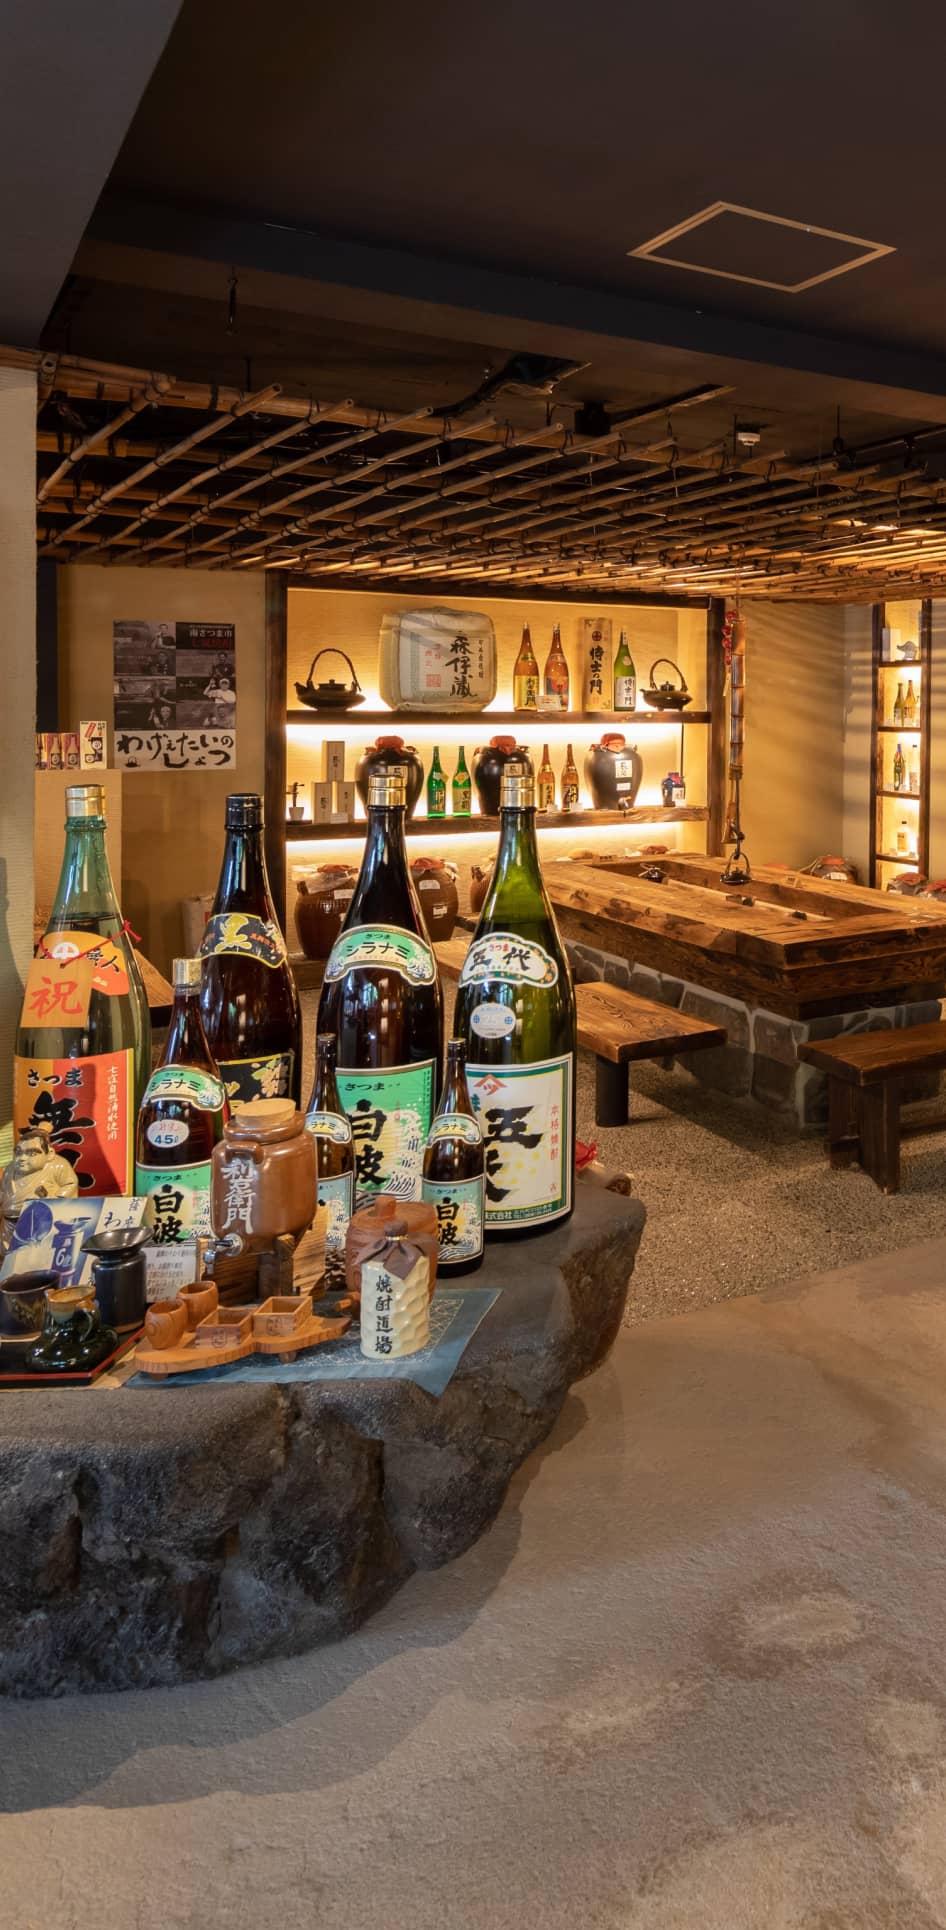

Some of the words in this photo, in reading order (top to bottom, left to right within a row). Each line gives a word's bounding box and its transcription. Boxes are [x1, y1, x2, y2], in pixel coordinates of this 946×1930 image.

[215, 914, 252, 953] 黒
[347, 942, 410, 960] シラナミ
[489, 943, 509, 952] さつま
[28, 976, 83, 1020] 祝
[28, 1068, 83, 1087] さつま
[151, 1078, 201, 1092] シラナミ
[344, 1082, 385, 1092] さつま
[151, 1184, 186, 1244] 白波
[220, 1158, 256, 1234] 利右衛門
[436, 1197, 461, 1247] 白波
[375, 1274, 393, 1354] 焼酎道場
